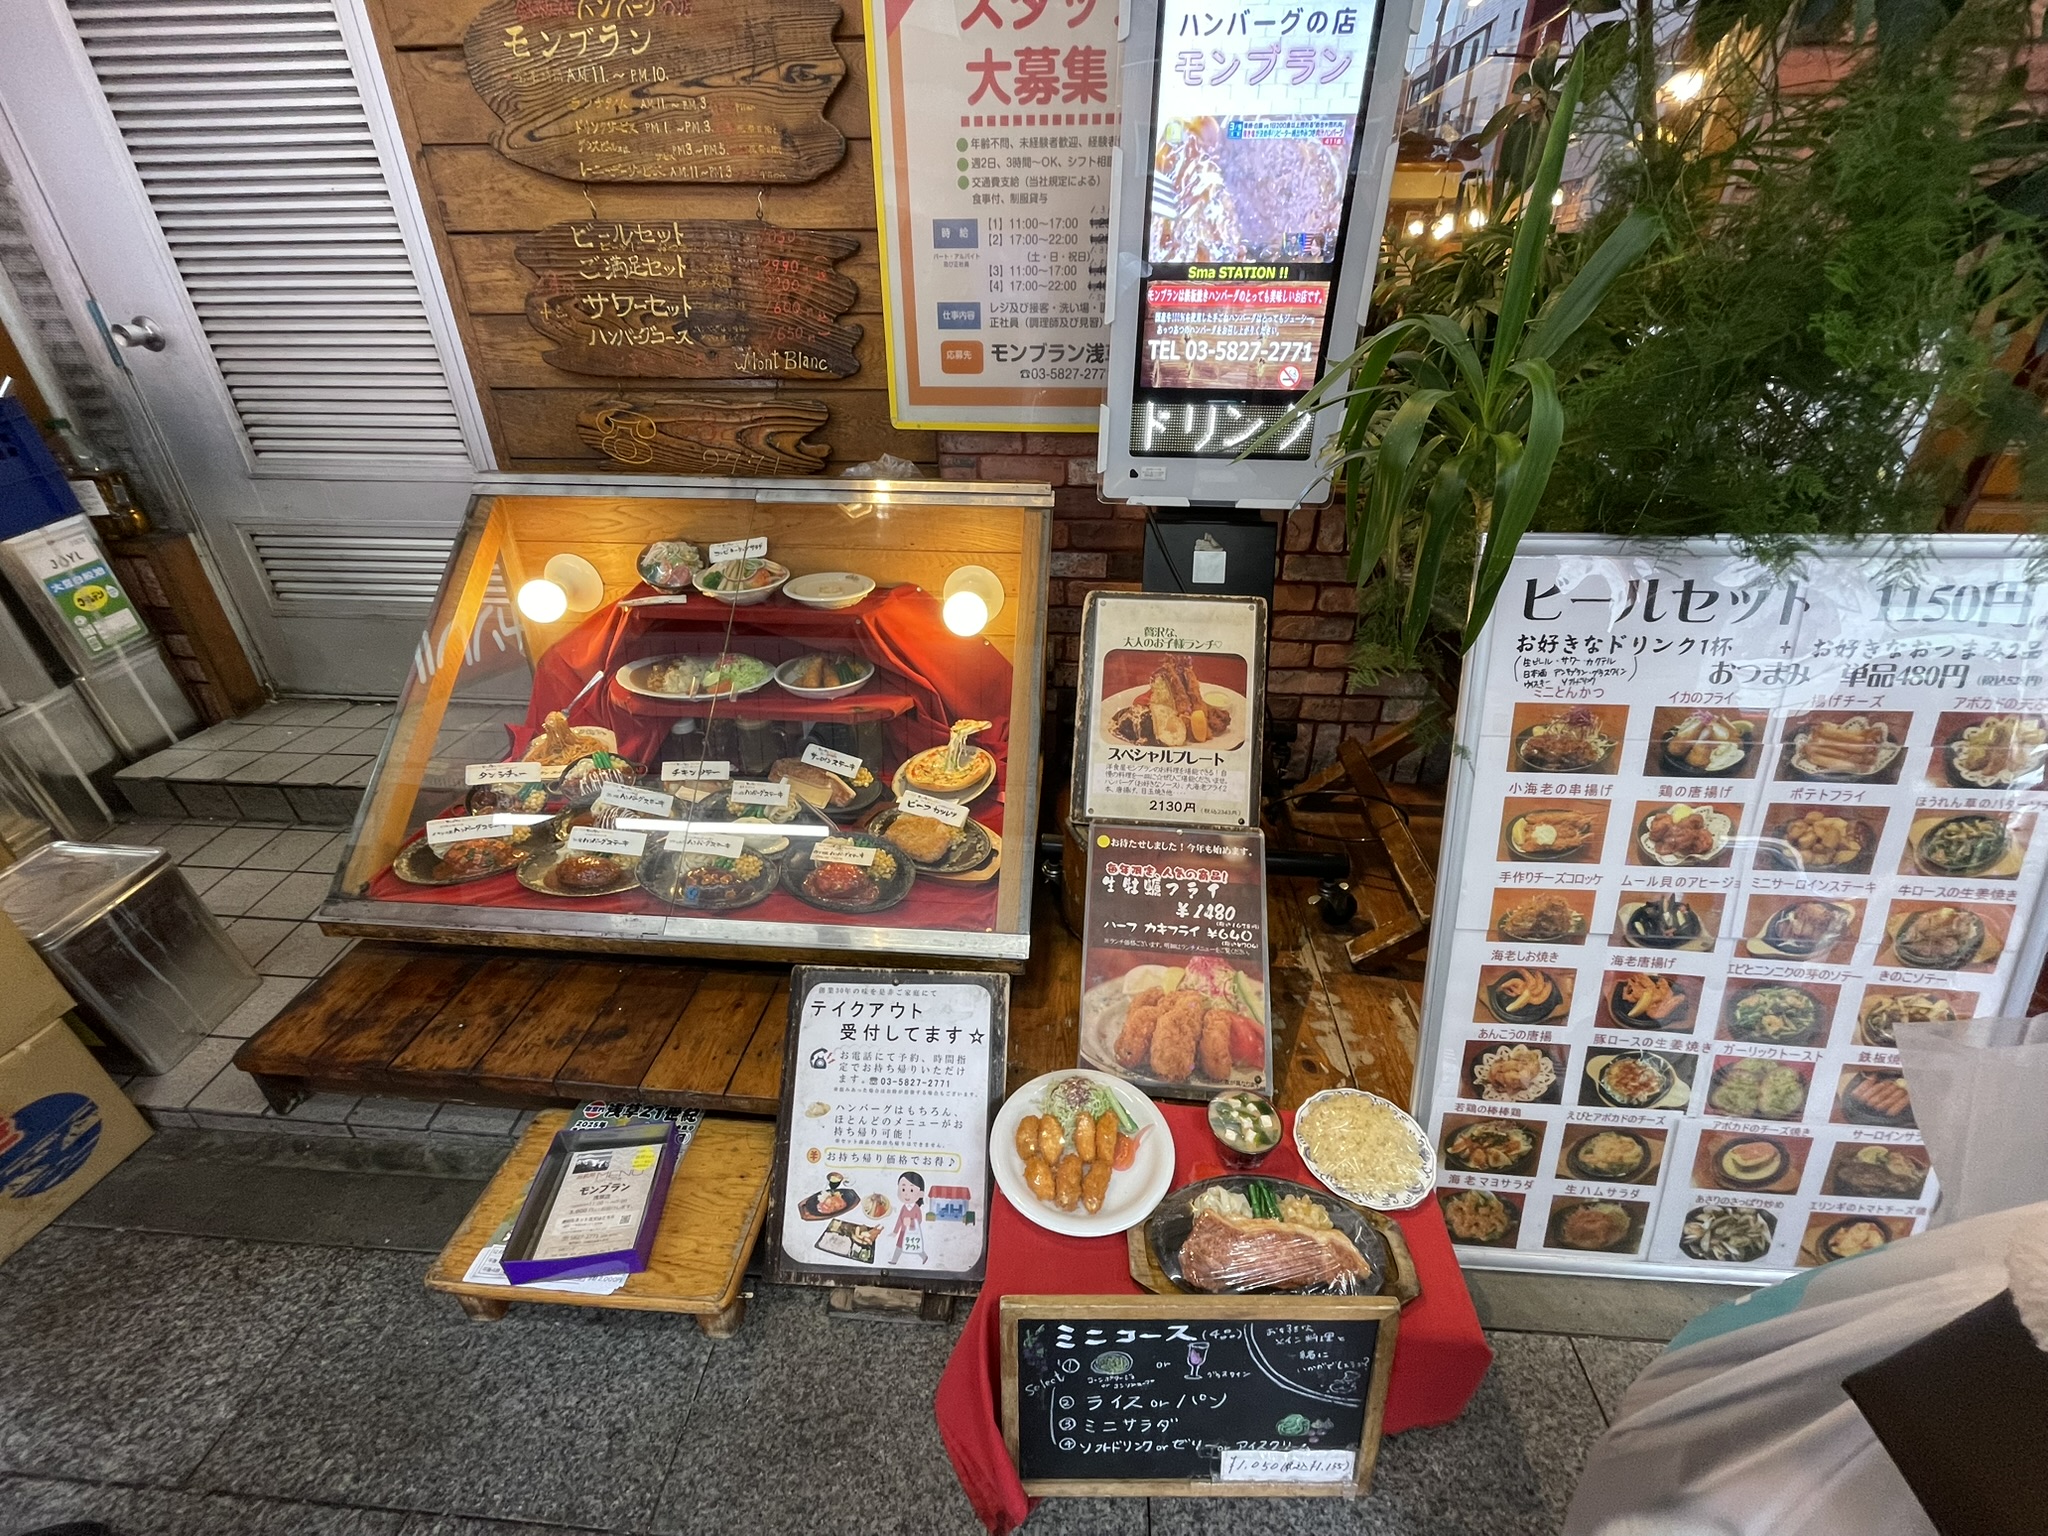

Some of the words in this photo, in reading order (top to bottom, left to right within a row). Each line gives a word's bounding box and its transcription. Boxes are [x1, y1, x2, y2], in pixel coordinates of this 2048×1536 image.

[961, 0, 1119, 30] スタッ
[1179, 8, 1358, 37] ハンバーグの店
[504, 25, 651, 58] モンブラン
[1175, 44, 1352, 87] モンブラン
[966, 45, 1109, 106] 大募集
[972, 193, 1048, 205] 食事付、制服貸与
[571, 221, 684, 247] ビールセット
[580, 254, 687, 280] ご満足セット
[1188, 266, 1216, 279] Sma
[1218, 266, 1276, 279] STATION
[582, 294, 692, 318] サワーセット
[942, 311, 976, 322] 仕事内容
[589, 327, 695, 348] ハンバーグコース
[734, 346, 780, 373] Mont
[991, 343, 1109, 364] モンブラン浅
[1148, 340, 1181, 360] TEL
[1185, 340, 1313, 362] 03-5827-2771
[1869, 582, 2035, 629] 1150円
[1516, 633, 1734, 657] お好きなドリンク1杯
[1812, 637, 2043, 661] お好きなおつまみ2品
[1708, 661, 1811, 686] おつまみ
[1841, 663, 1971, 689] 単品480円
[1533, 686, 1605, 699] ミニとんかつ
[1668, 691, 1736, 705] イカのフライ
[1811, 694, 1886, 709] 揚げチーズ
[1107, 746, 1225, 767] スペシャルプレート
[1508, 782, 1615, 798] 小海老の串揚げ
[1658, 785, 1735, 799] 鶏の唐揚げ
[1790, 788, 1867, 803] ポテトフライ
[907, 799, 931, 811] ビーフ
[1149, 799, 1196, 814] 2130円
[1498, 870, 1605, 886] 手作りチーズコロッケ
[1620, 874, 1740, 889] ムール貝のアヒージョ
[1751, 876, 1877, 894] ミニサーロインステーキ
[1102, 876, 1220, 899] 生牡蠣フライ
[1897, 884, 2018, 902] 牛ロースの生姜焼き
[1103, 920, 1138, 932] ハーフ
[1143, 922, 1201, 938] カキフライ
[1490, 948, 1560, 964] 海老しお焼き
[1609, 954, 1678, 970] 海老唐揚げ
[1727, 963, 1864, 982] エビとニンニクの芽のソテー
[1878, 969, 1948, 984] きのこソテー
[811, 1000, 923, 1020] テイクアウト
[1592, 1033, 1713, 1054] 豚ロースの生姜焼き
[839, 1050, 967, 1065] お電話にて予約、時間指
[1722, 1044, 1824, 1062] ガーリックトースト
[839, 1061, 966, 1076] 定でお持ち帰りいただけ
[603, 1102, 700, 1123] 浅草21世紀
[836, 1103, 960, 1118] ハンバーグはもちろん、
[1453, 1102, 1523, 1118] 若鶏の棒棒鶏
[1566, 1110, 1667, 1126] えびとアボカドのチーズ
[834, 1115, 964, 1130] ほとんどのメニューがお
[1712, 1120, 1812, 1137] アボカドのチーズ焼き
[579, 1182, 631, 1196] モンブラン
[1447, 1173, 1535, 1191] 海老マヨサラダ
[1564, 1184, 1641, 1200] 生ハムサラダ
[1055, 1324, 1197, 1349] ミニコース
[1155, 1360, 1172, 1370] or
[1086, 1393, 1144, 1411] ライス
[1150, 1399, 1168, 1410] or
[1176, 1392, 1229, 1411] パン
[1084, 1417, 1180, 1434] ミニサラダ
[1079, 1440, 1153, 1454] ソフトドリンク
[1155, 1443, 1168, 1452] or
